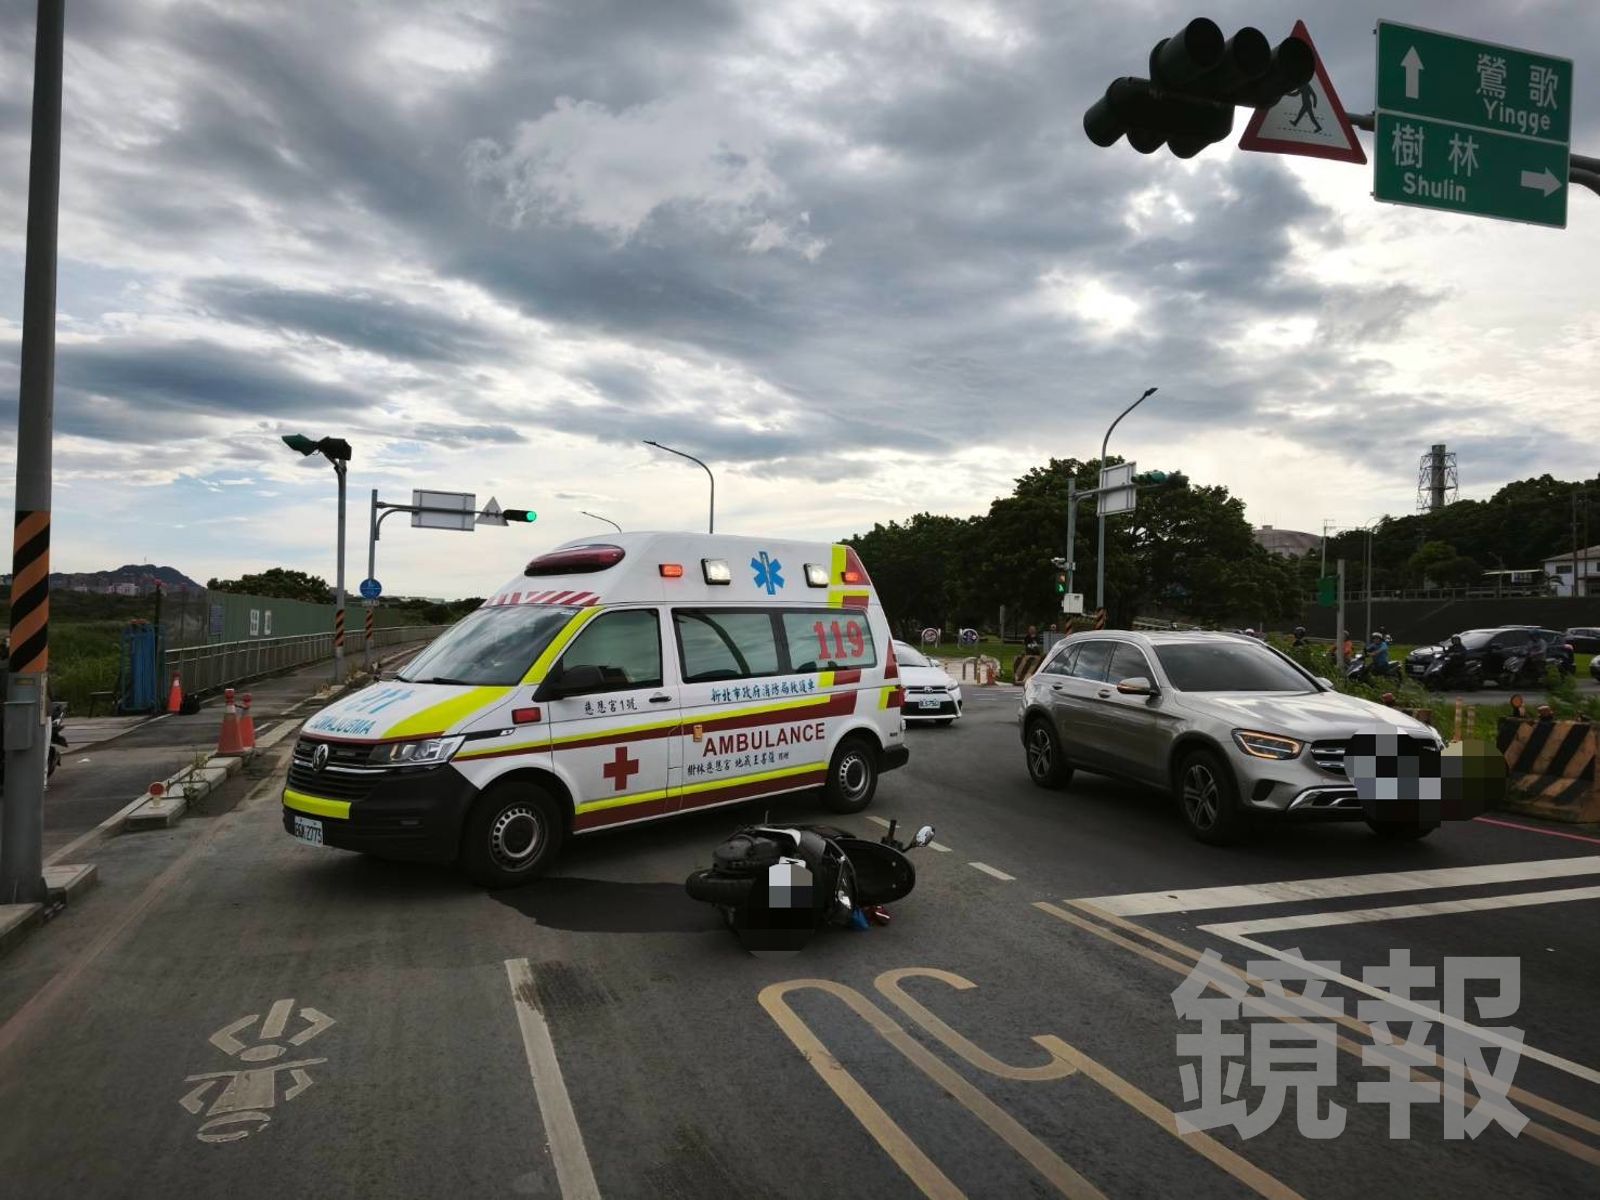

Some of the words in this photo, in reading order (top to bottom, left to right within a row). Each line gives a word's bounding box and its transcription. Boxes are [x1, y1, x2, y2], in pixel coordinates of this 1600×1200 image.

[1475, 53, 1560, 111] 鶯歌
[1482, 100, 1551, 135] Yingge
[1392, 123, 1480, 177] 樹林
[1403, 173, 1467, 203] Shulin
[813, 619, 865, 661] 119
[702, 722, 826, 758] AMBULANCE
